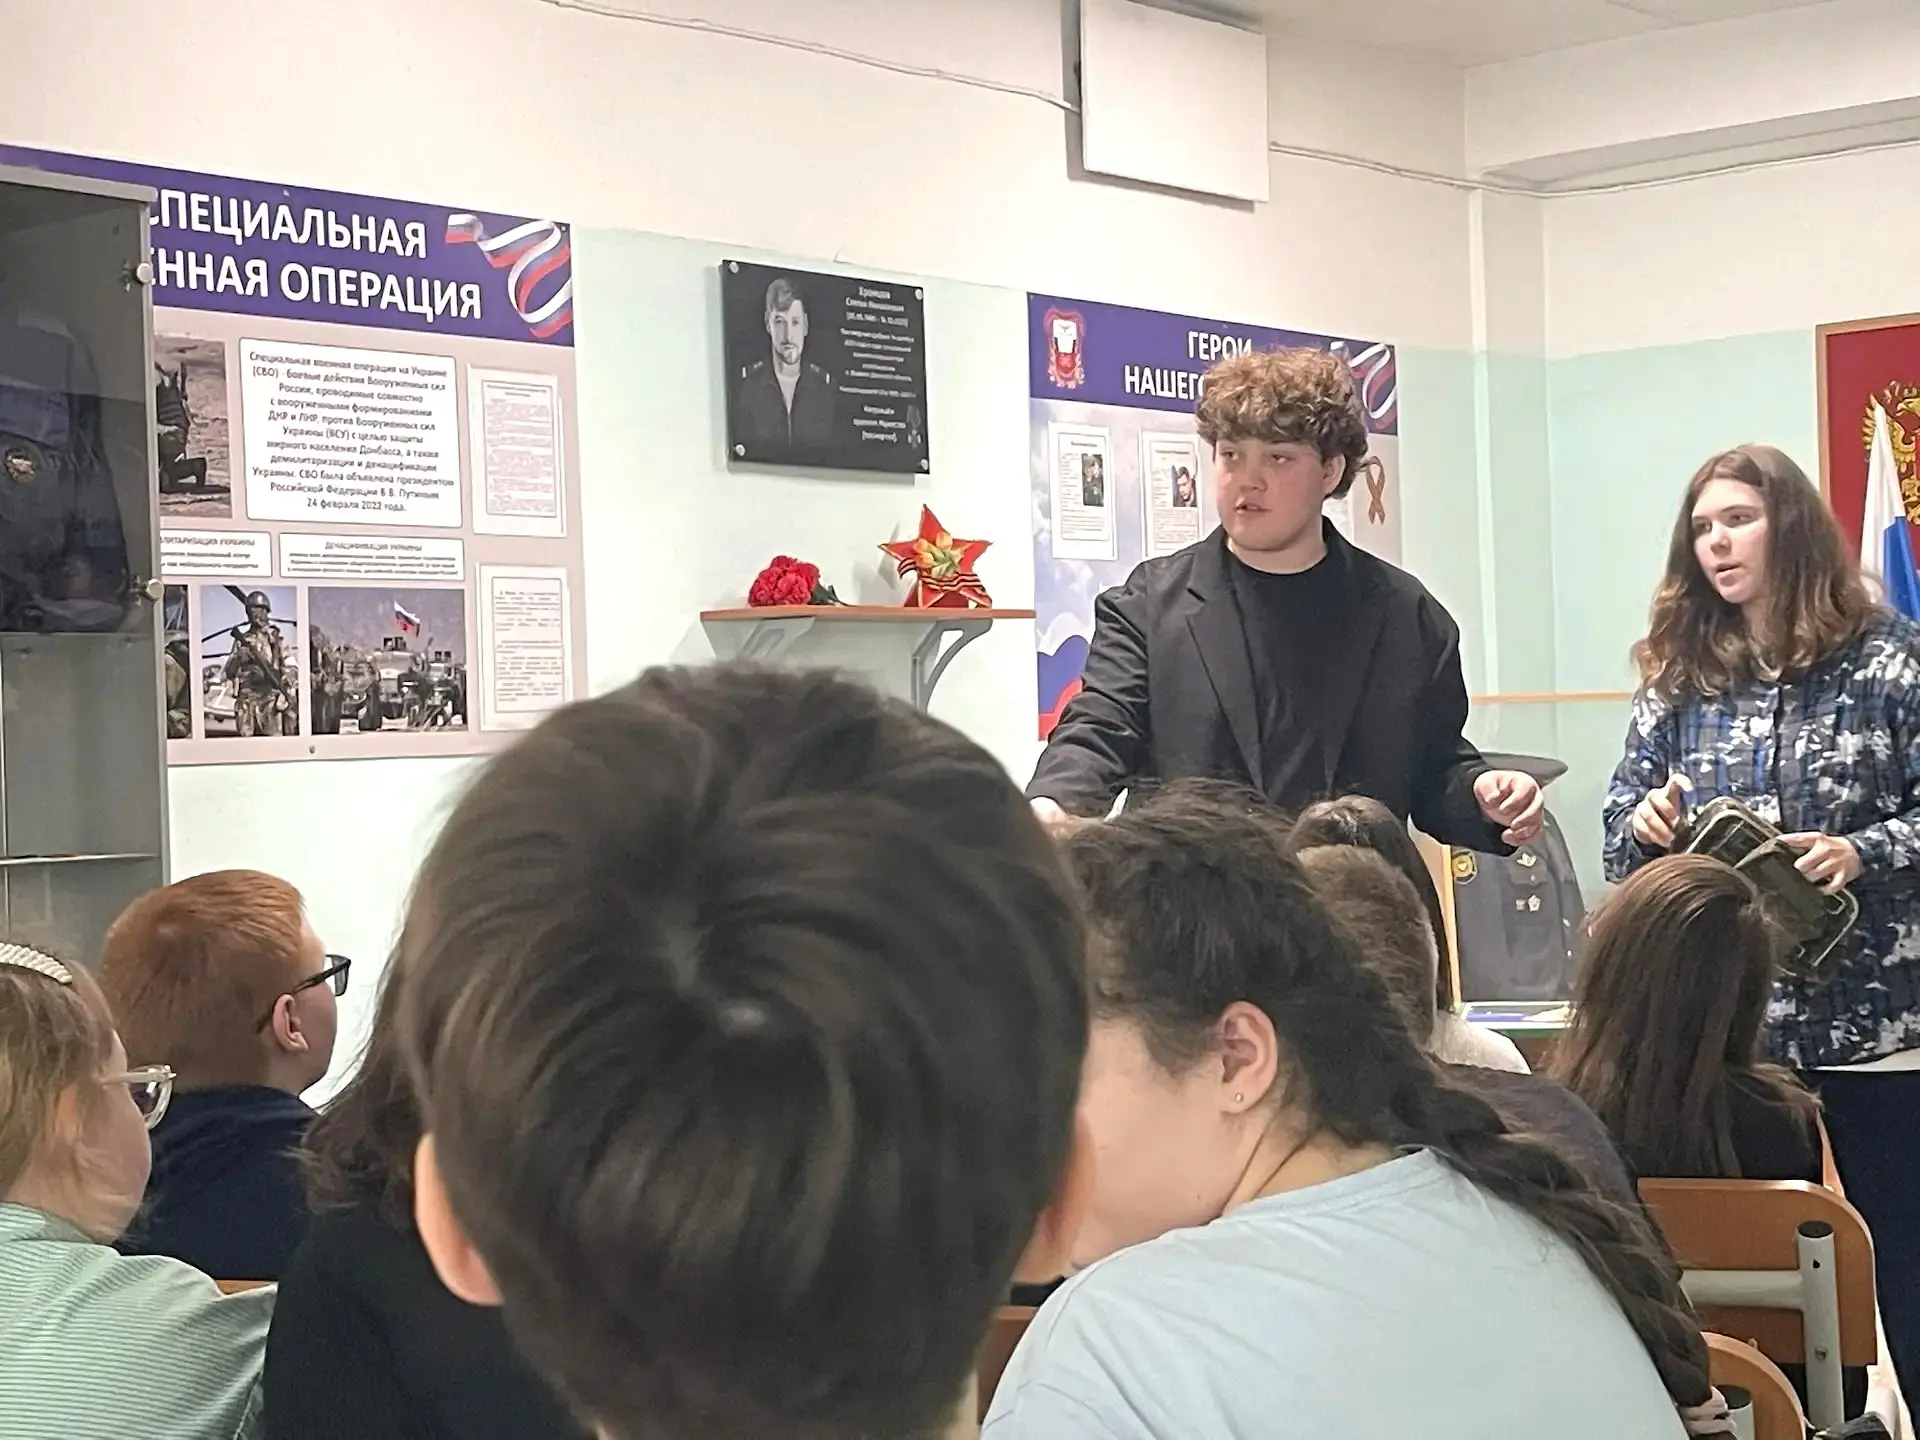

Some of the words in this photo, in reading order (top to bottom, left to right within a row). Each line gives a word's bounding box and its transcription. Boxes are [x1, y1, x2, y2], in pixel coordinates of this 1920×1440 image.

[149, 188, 427, 259] ПЕЦИАЛЬНАЯ
[150, 247, 269, 298] ННАЯ
[280, 262, 482, 324] ОПЕРАЦИЯ
[1188, 330, 1252, 362] ГЕРОИ
[249, 351, 311, 365] Специальная
[252, 366, 278, 378] (СВО)
[323, 372, 364, 384] действия
[298, 469, 318, 479] СВО
[307, 497, 317, 507] 24
[361, 500, 382, 510] 2022
